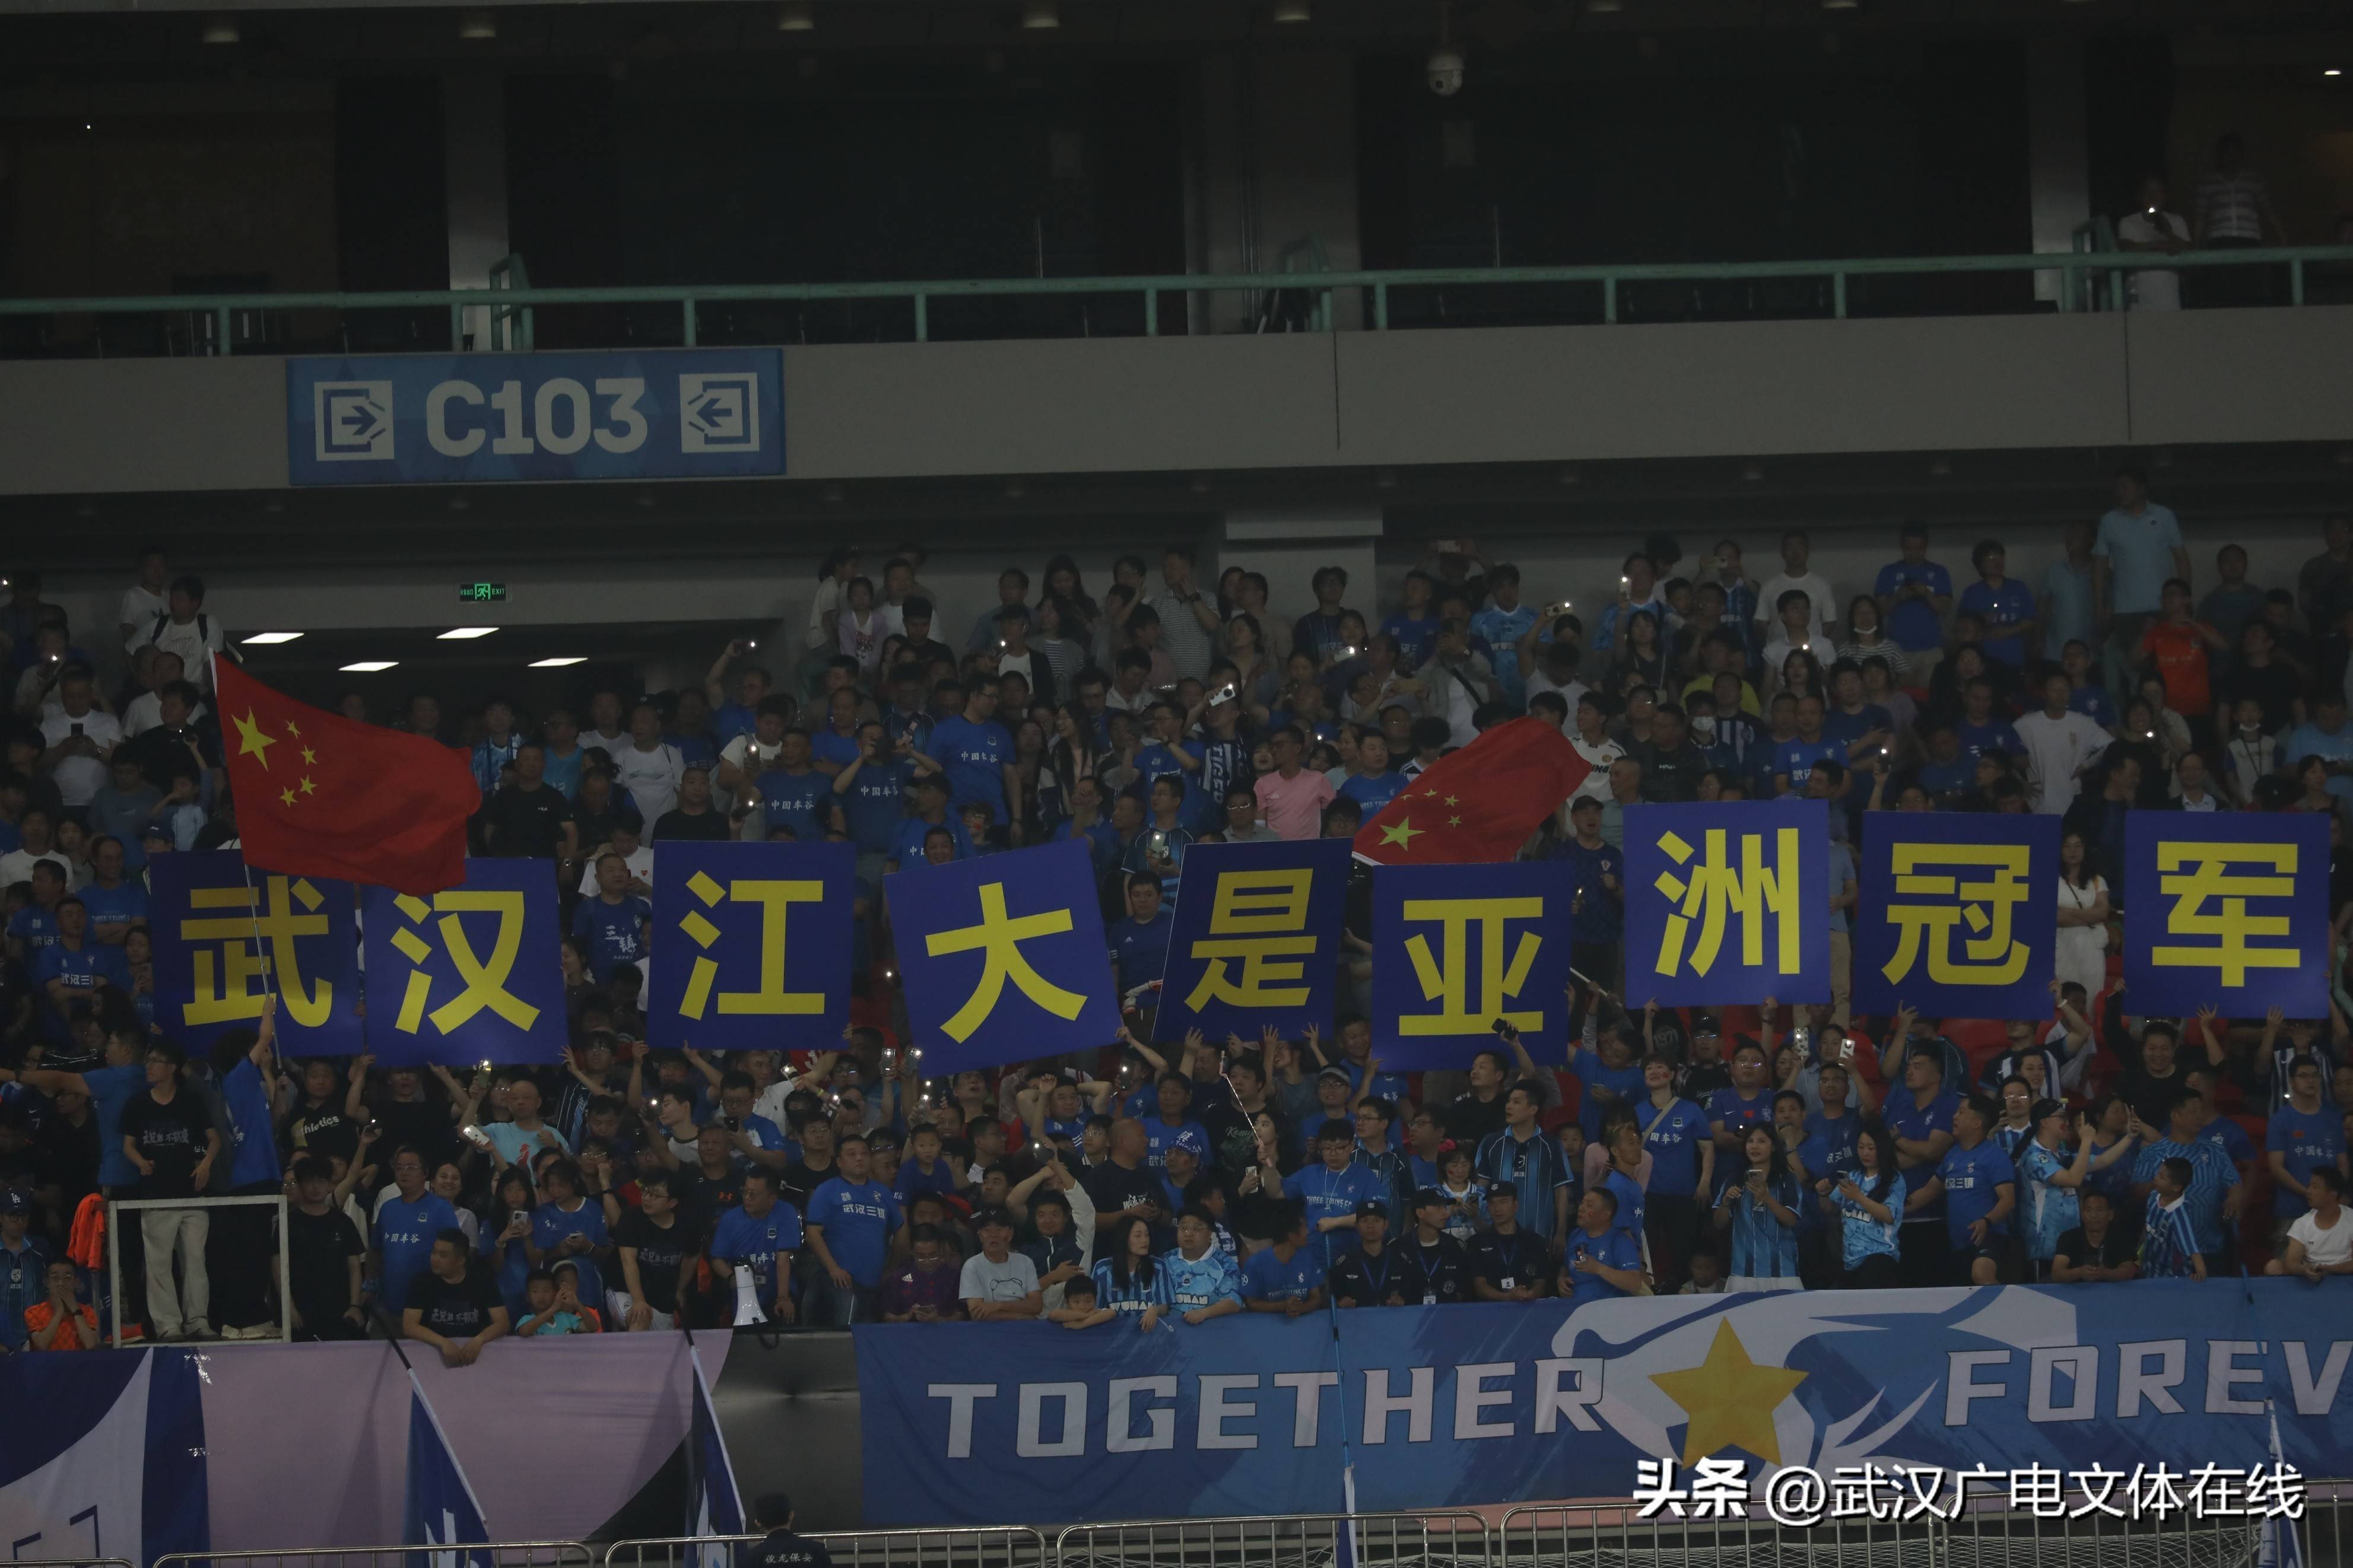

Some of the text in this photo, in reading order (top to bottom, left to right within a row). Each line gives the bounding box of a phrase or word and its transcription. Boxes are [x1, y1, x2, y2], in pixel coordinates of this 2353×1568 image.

[426, 377, 648, 457] C103
[771, 799, 815, 812] 中国车谷
[2294, 1144, 2335, 1160] 中国车谷
[842, 1204, 887, 1220] 武汉三镇
[926, 1338, 2353, 1459] TOGETHER FOREV
